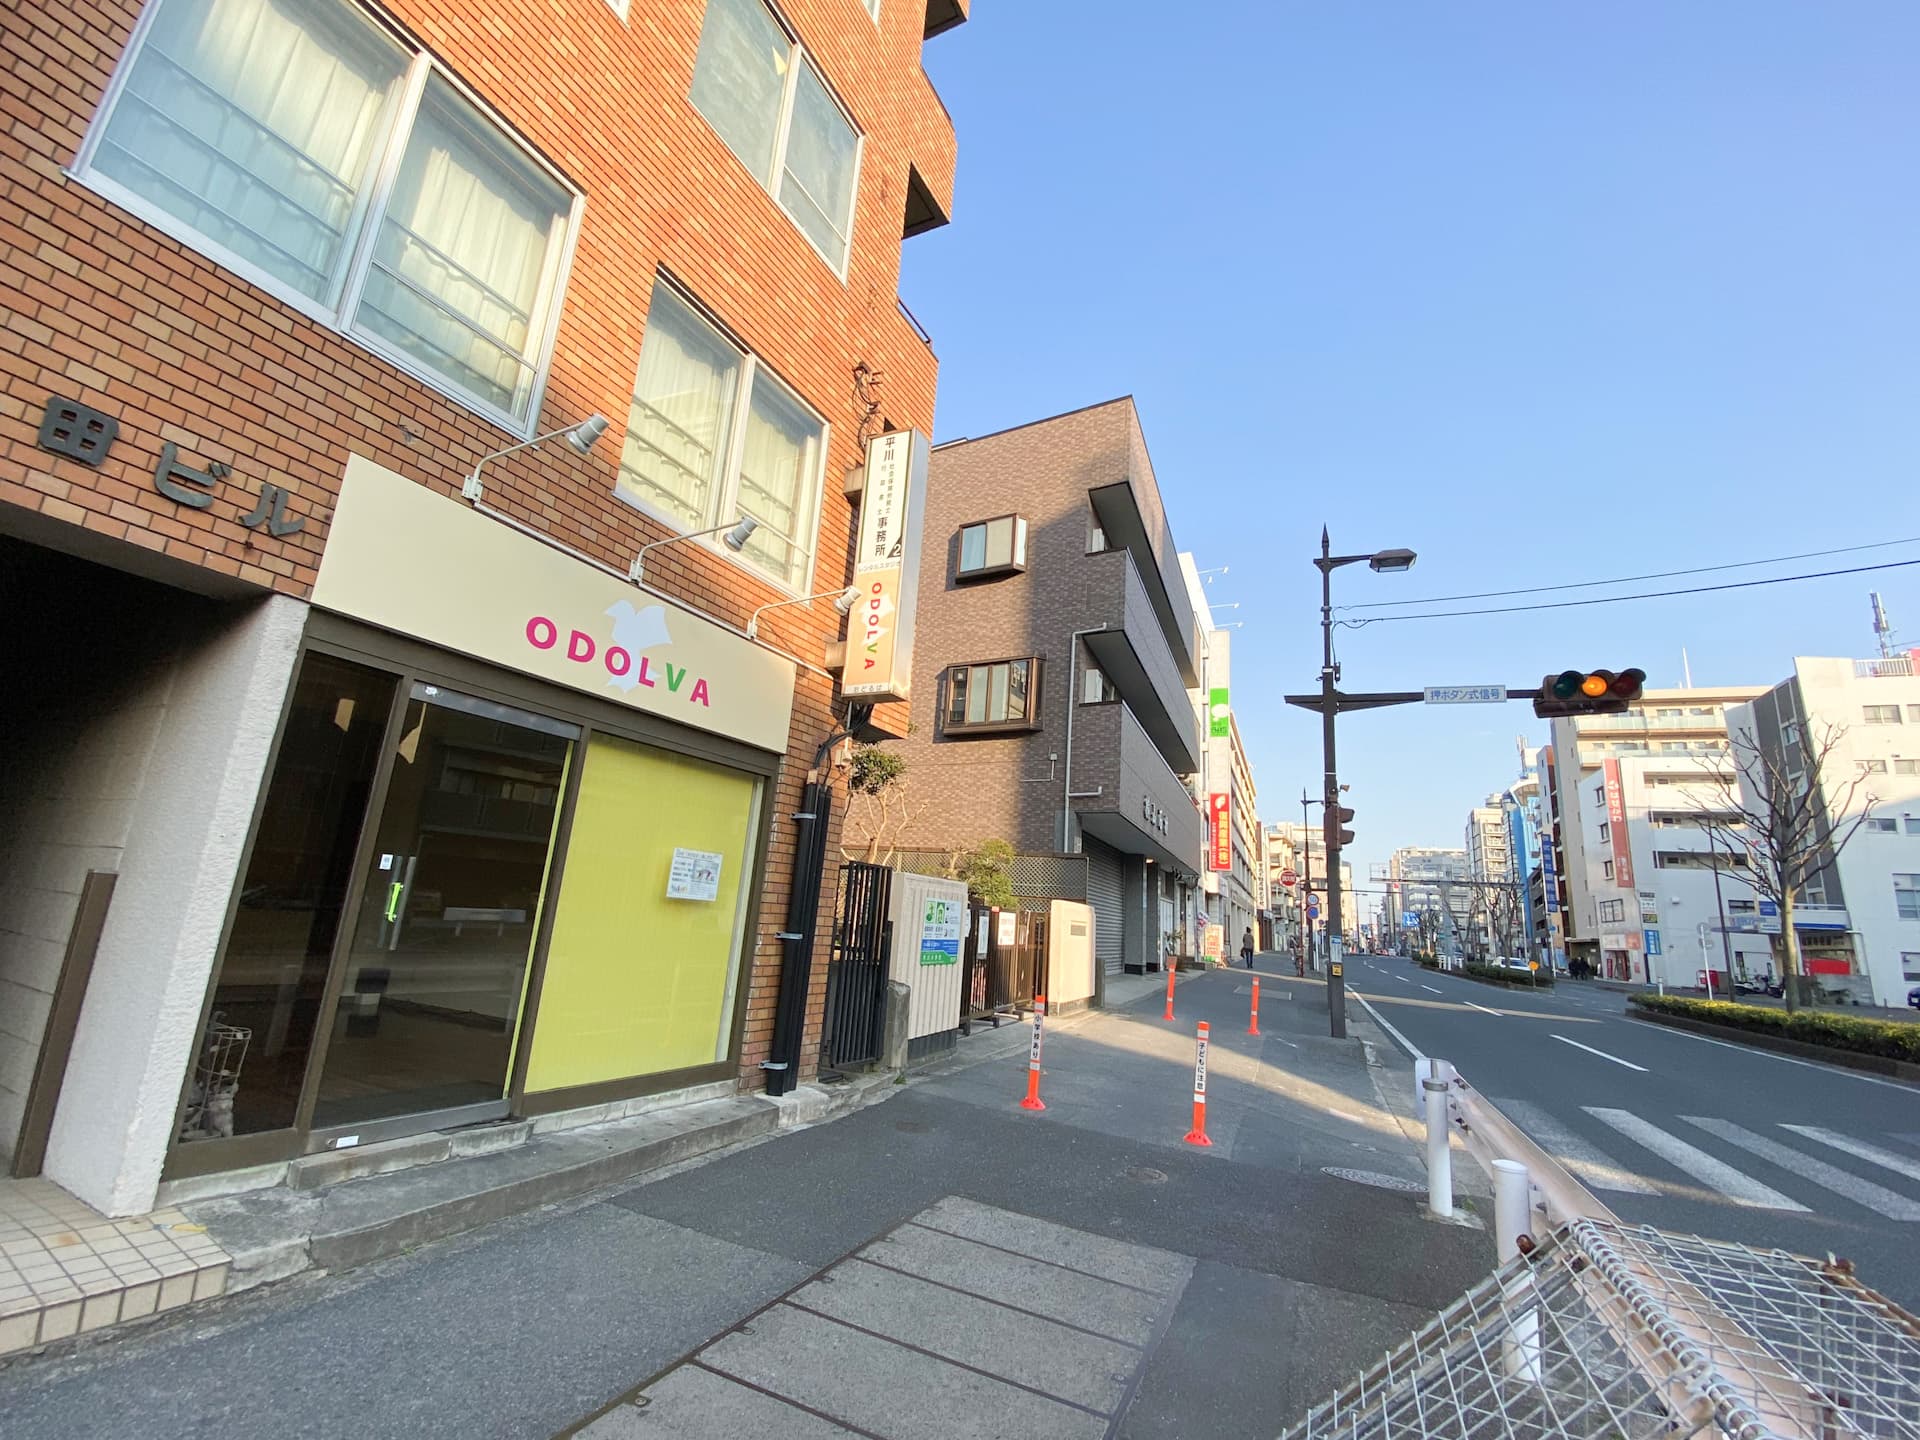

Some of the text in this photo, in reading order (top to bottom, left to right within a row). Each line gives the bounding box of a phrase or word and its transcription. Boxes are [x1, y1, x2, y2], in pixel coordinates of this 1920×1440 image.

[884, 436, 896, 461] 平川
[875, 517, 888, 556] 事務所
[864, 582, 882, 670] ODOLVA
[525, 616, 710, 707] ODOLVA
[1431, 688, 1499, 700] 押ボタン式信号
[1033, 1014, 1041, 1058] 小学校あり
